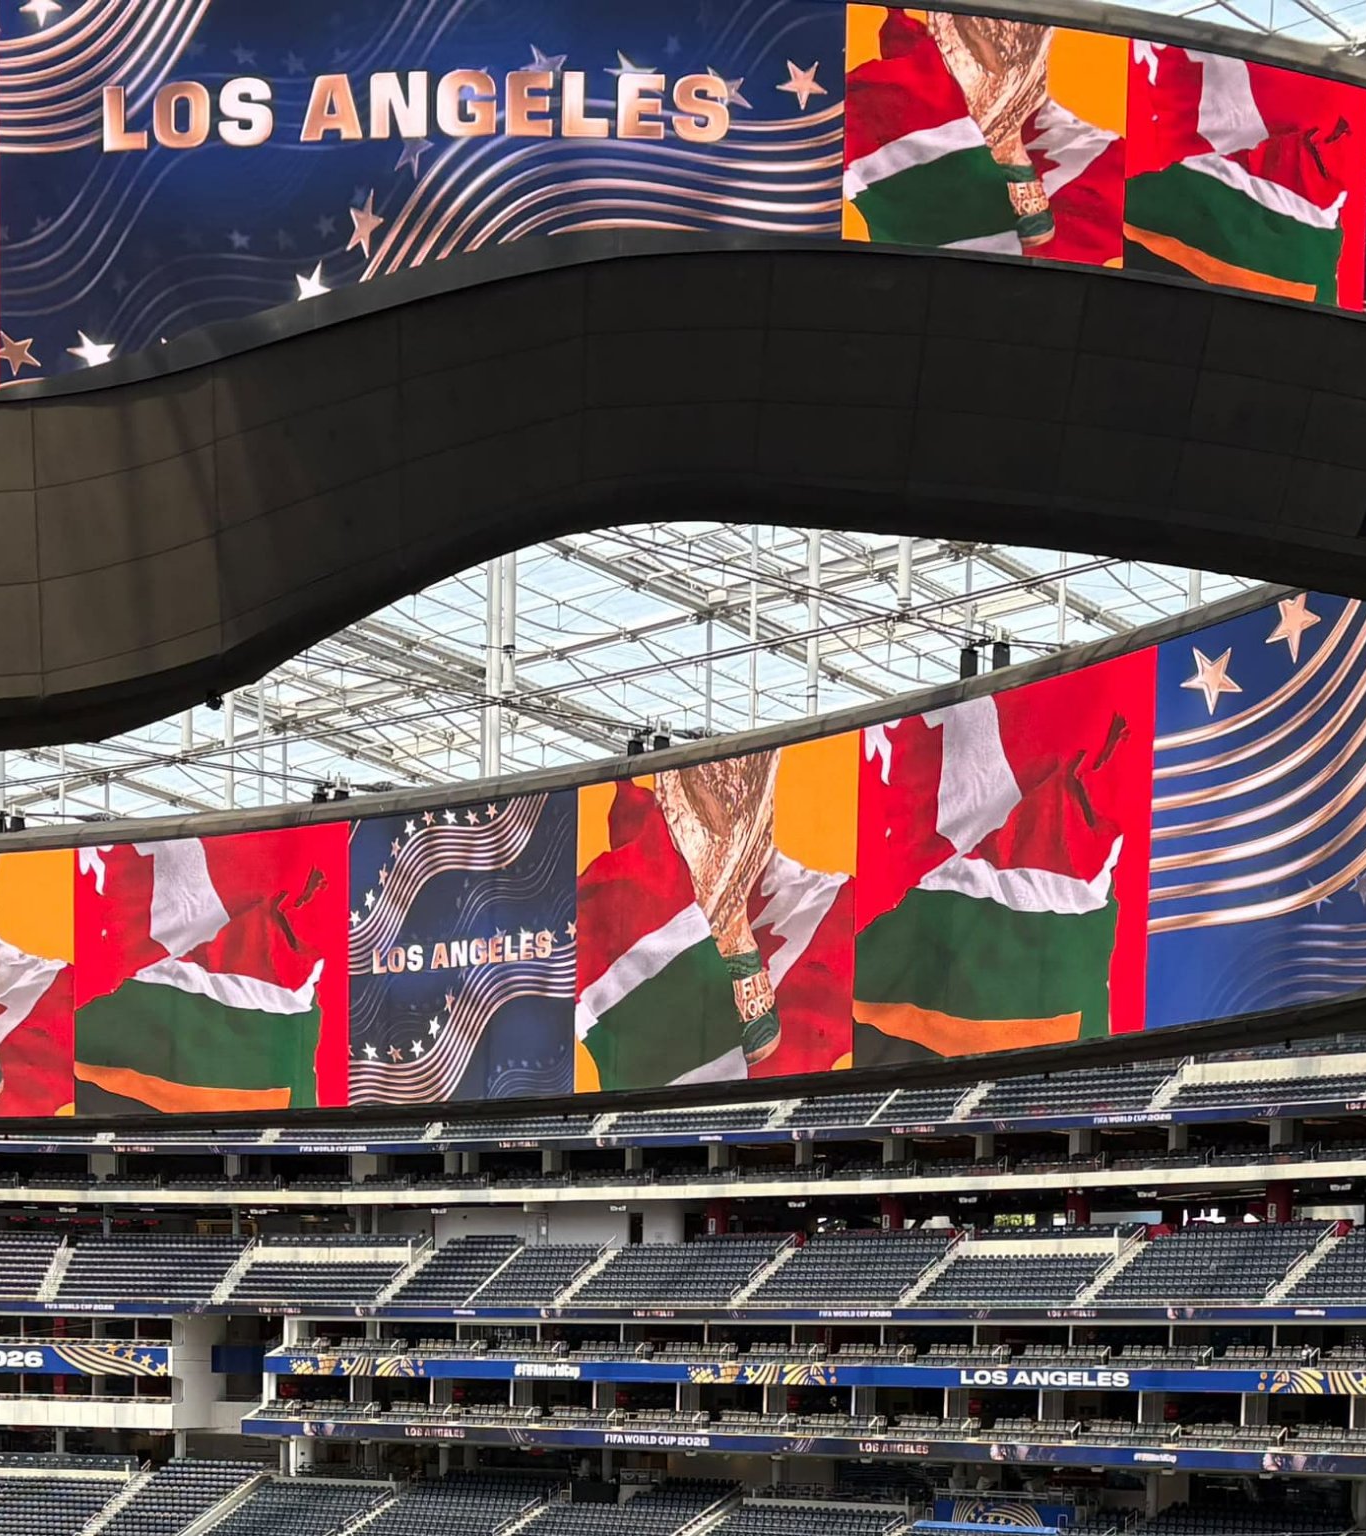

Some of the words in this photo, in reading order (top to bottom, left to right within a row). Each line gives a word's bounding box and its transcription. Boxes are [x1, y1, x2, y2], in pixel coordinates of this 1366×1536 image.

[103, 76, 273, 153] LOS
[300, 70, 731, 142] ANGELES
[372, 945, 424, 975] LOS
[430, 931, 552, 970] ANGELES
[960, 1370, 1008, 1386] LOS
[1013, 1371, 1130, 1387] ANGELES
[604, 1434, 624, 1444] FIFA
[625, 1434, 656, 1445] WORLD
[658, 1436, 676, 1446] CUP
[677, 1437, 709, 1447] 2026
[859, 1442, 879, 1453] LOS
